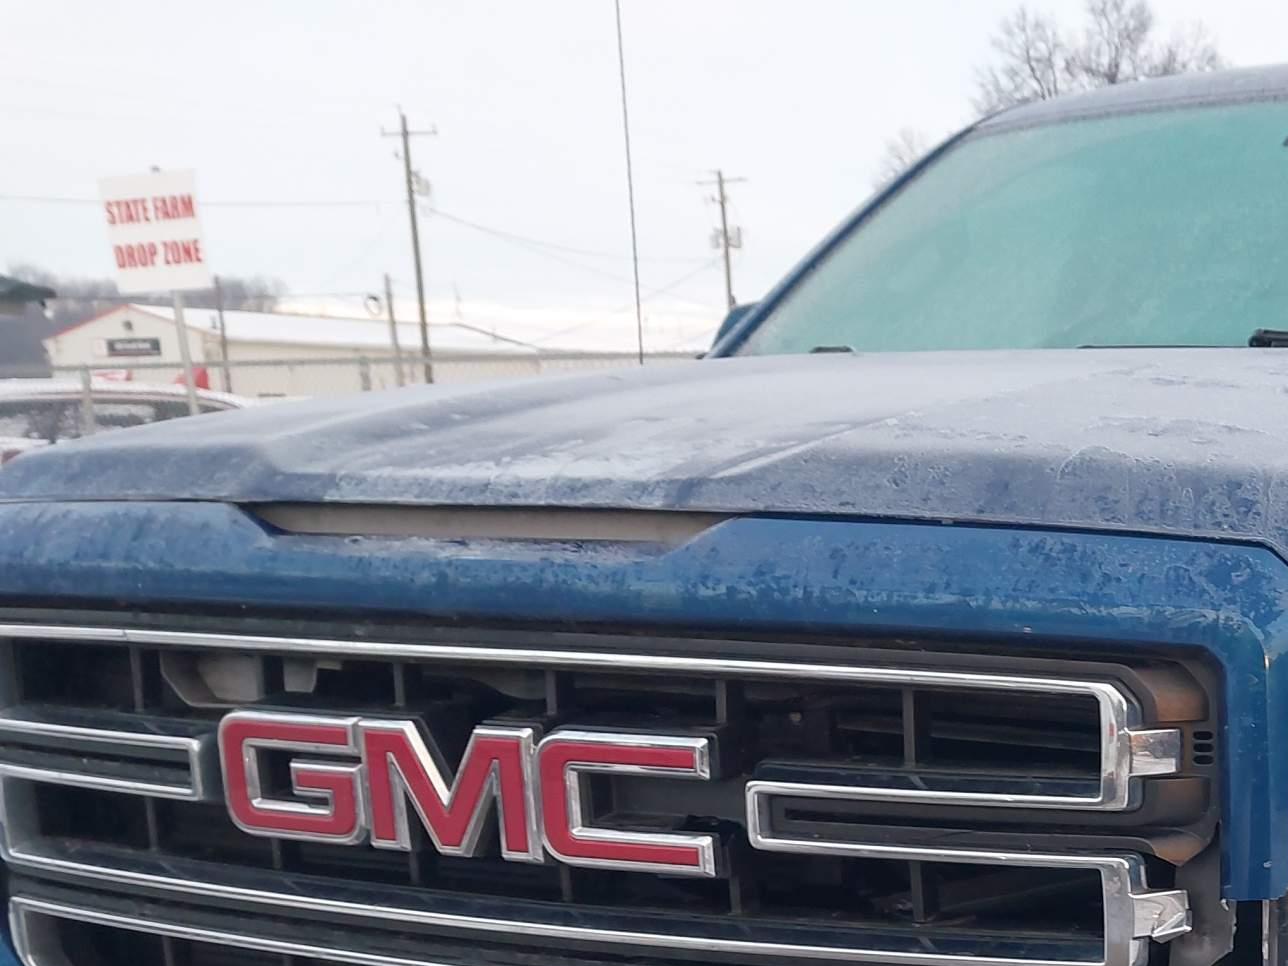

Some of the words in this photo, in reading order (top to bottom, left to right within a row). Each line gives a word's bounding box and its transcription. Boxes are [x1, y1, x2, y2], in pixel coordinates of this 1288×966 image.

[105, 197, 150, 224] STATE
[152, 194, 194, 220] FARM
[114, 242, 157, 268] DROP
[162, 239, 202, 264] ZONE
[218, 711, 715, 877] GMC
